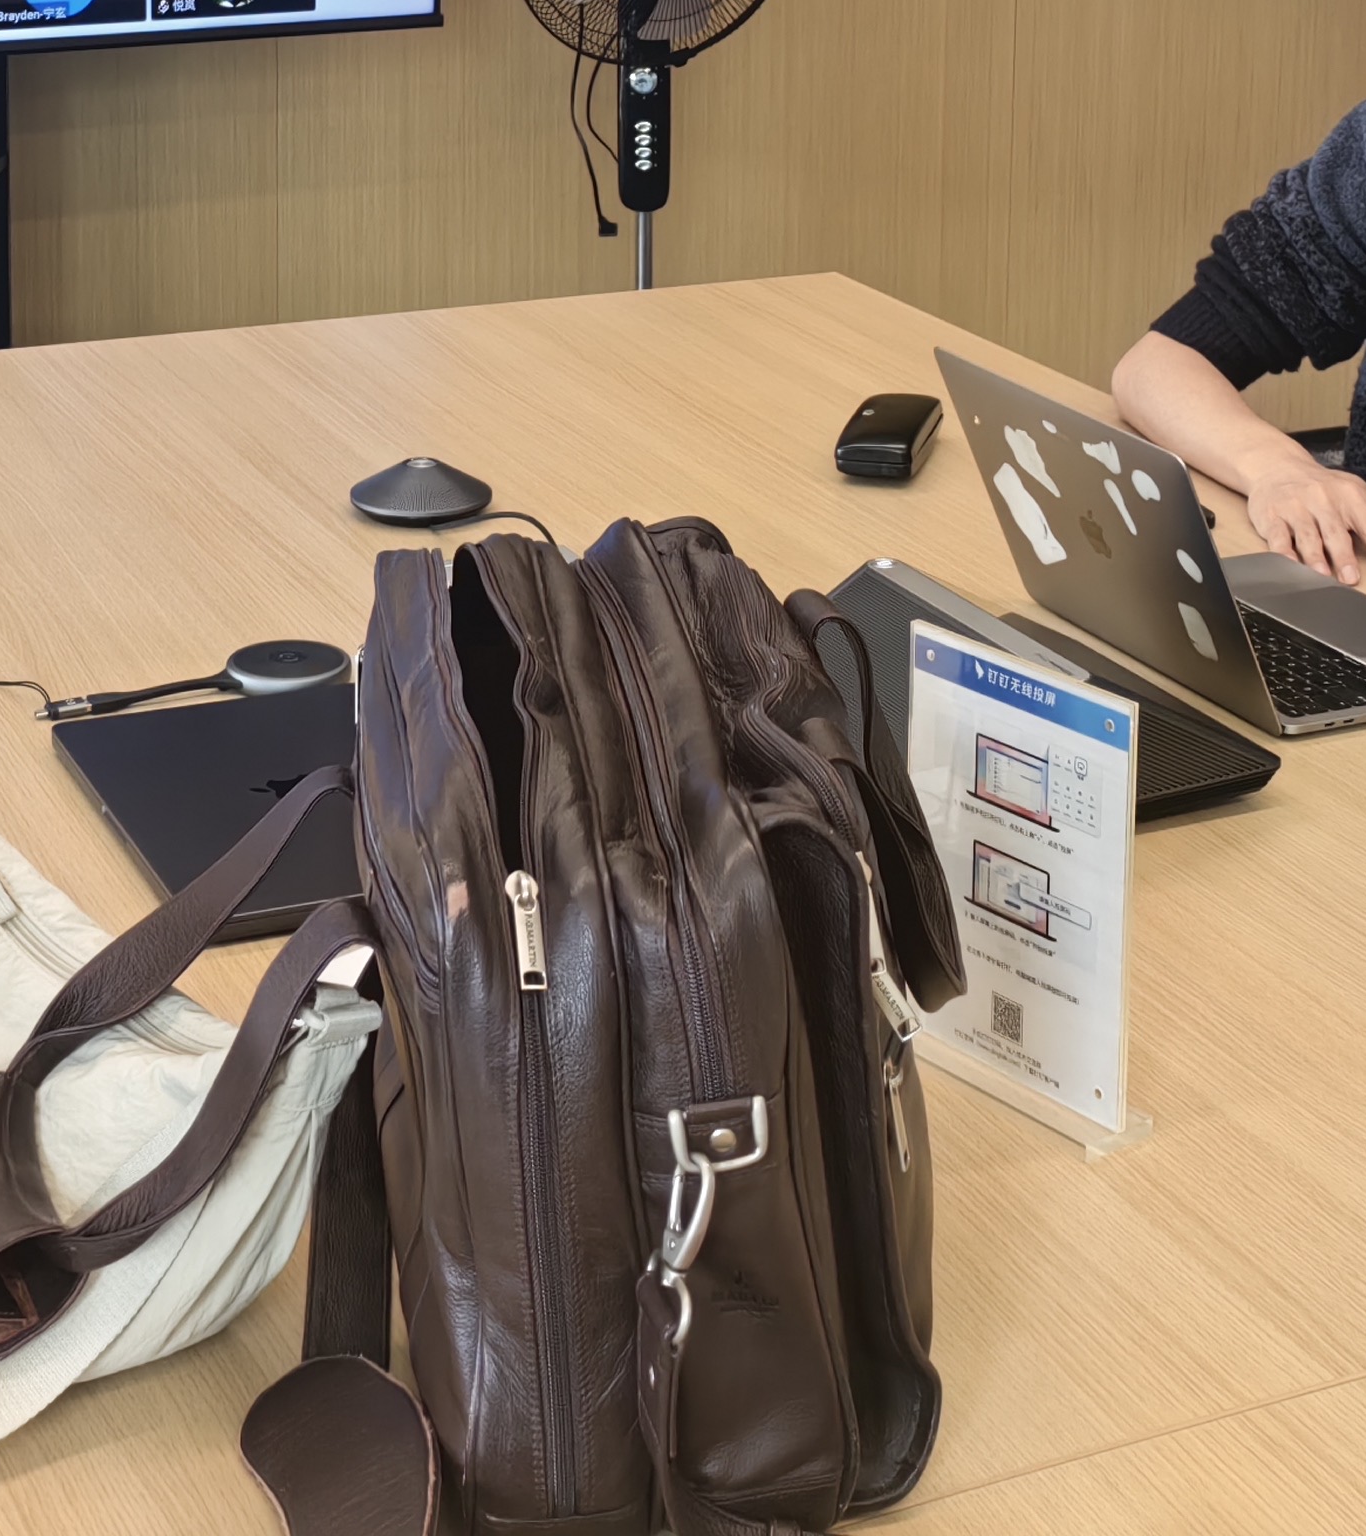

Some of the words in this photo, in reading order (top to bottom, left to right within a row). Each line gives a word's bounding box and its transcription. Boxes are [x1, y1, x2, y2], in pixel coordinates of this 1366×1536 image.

[987, 667, 1056, 707] 钉钉无线投屏
